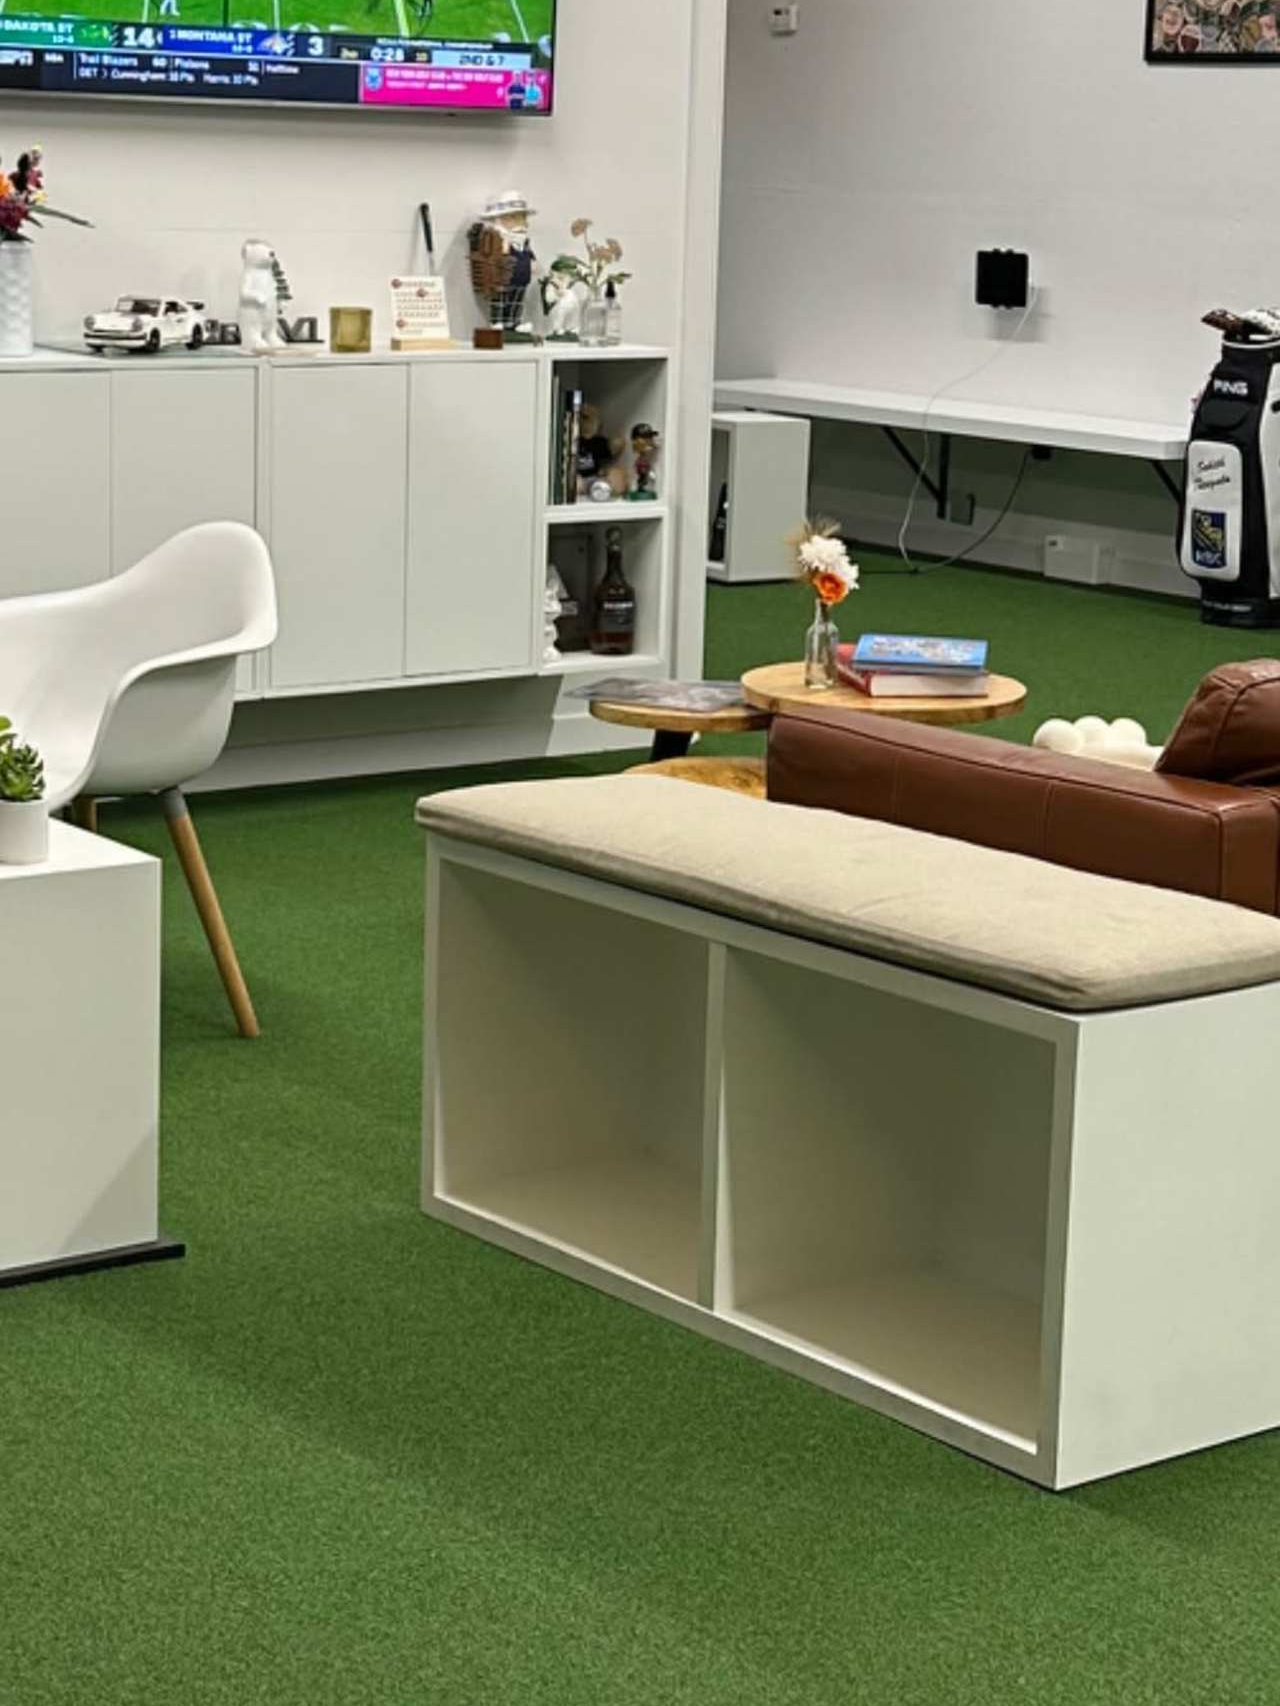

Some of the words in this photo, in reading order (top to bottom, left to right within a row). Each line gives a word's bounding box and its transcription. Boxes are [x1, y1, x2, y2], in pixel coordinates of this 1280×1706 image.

[123, 26, 155, 48] 14
[308, 36, 324, 56] 3
[1213, 378, 1249, 396] PING
